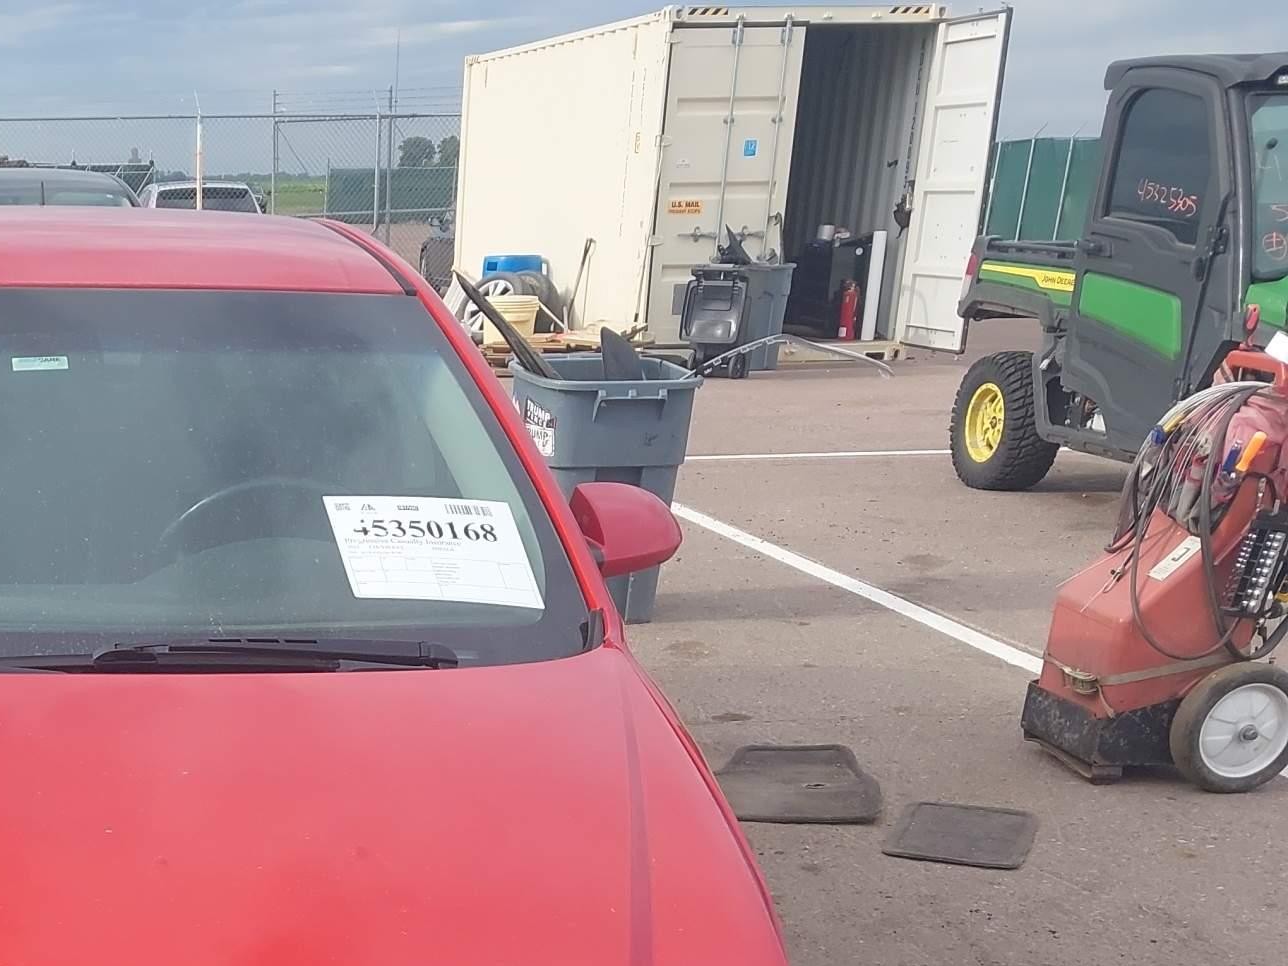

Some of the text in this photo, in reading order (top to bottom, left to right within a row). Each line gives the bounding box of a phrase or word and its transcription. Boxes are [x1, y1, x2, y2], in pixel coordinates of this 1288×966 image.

[1041, 274, 1075, 286] JOHN DEERE
[527, 399, 551, 421] TRUMP
[353, 519, 498, 543] 45350168
